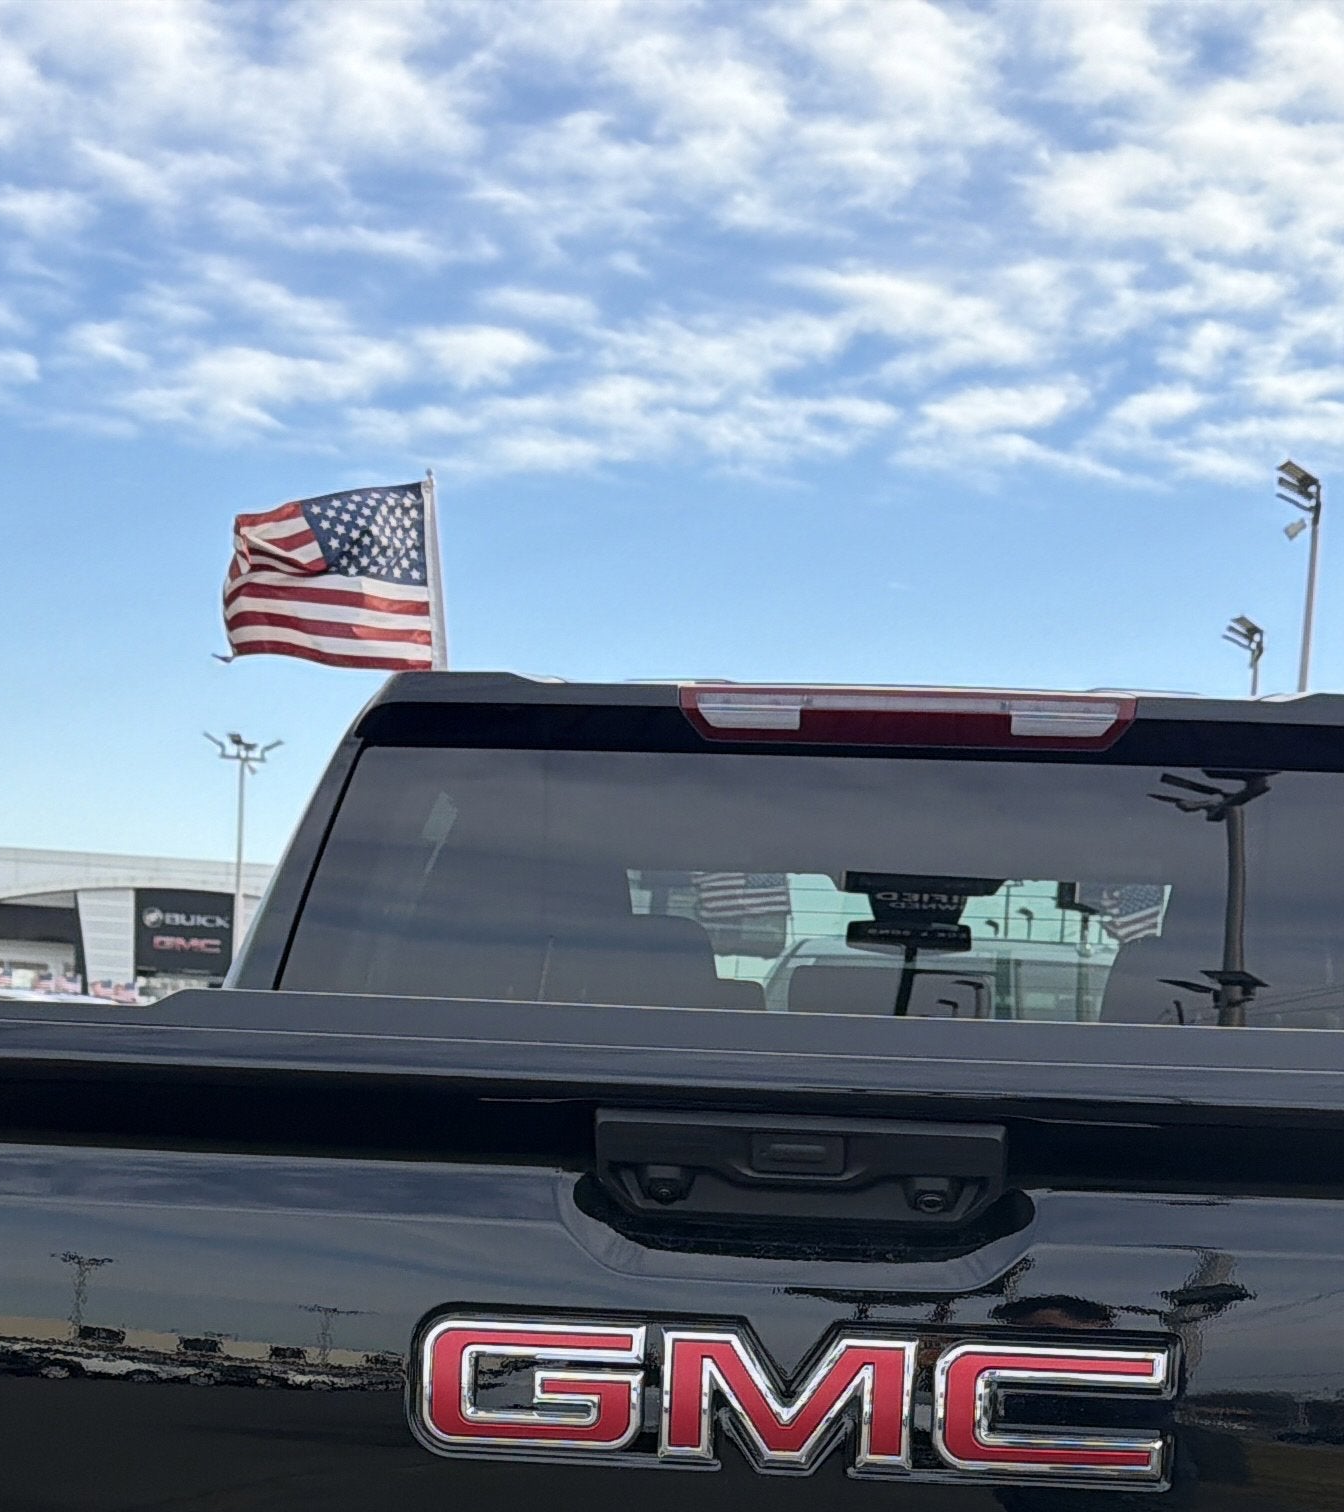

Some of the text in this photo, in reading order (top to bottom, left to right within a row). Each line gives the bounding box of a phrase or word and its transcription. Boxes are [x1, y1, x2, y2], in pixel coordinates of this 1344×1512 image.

[164, 912, 230, 929] BUICK
[152, 935, 222, 954] GMC
[422, 1314, 1176, 1482] GMC
